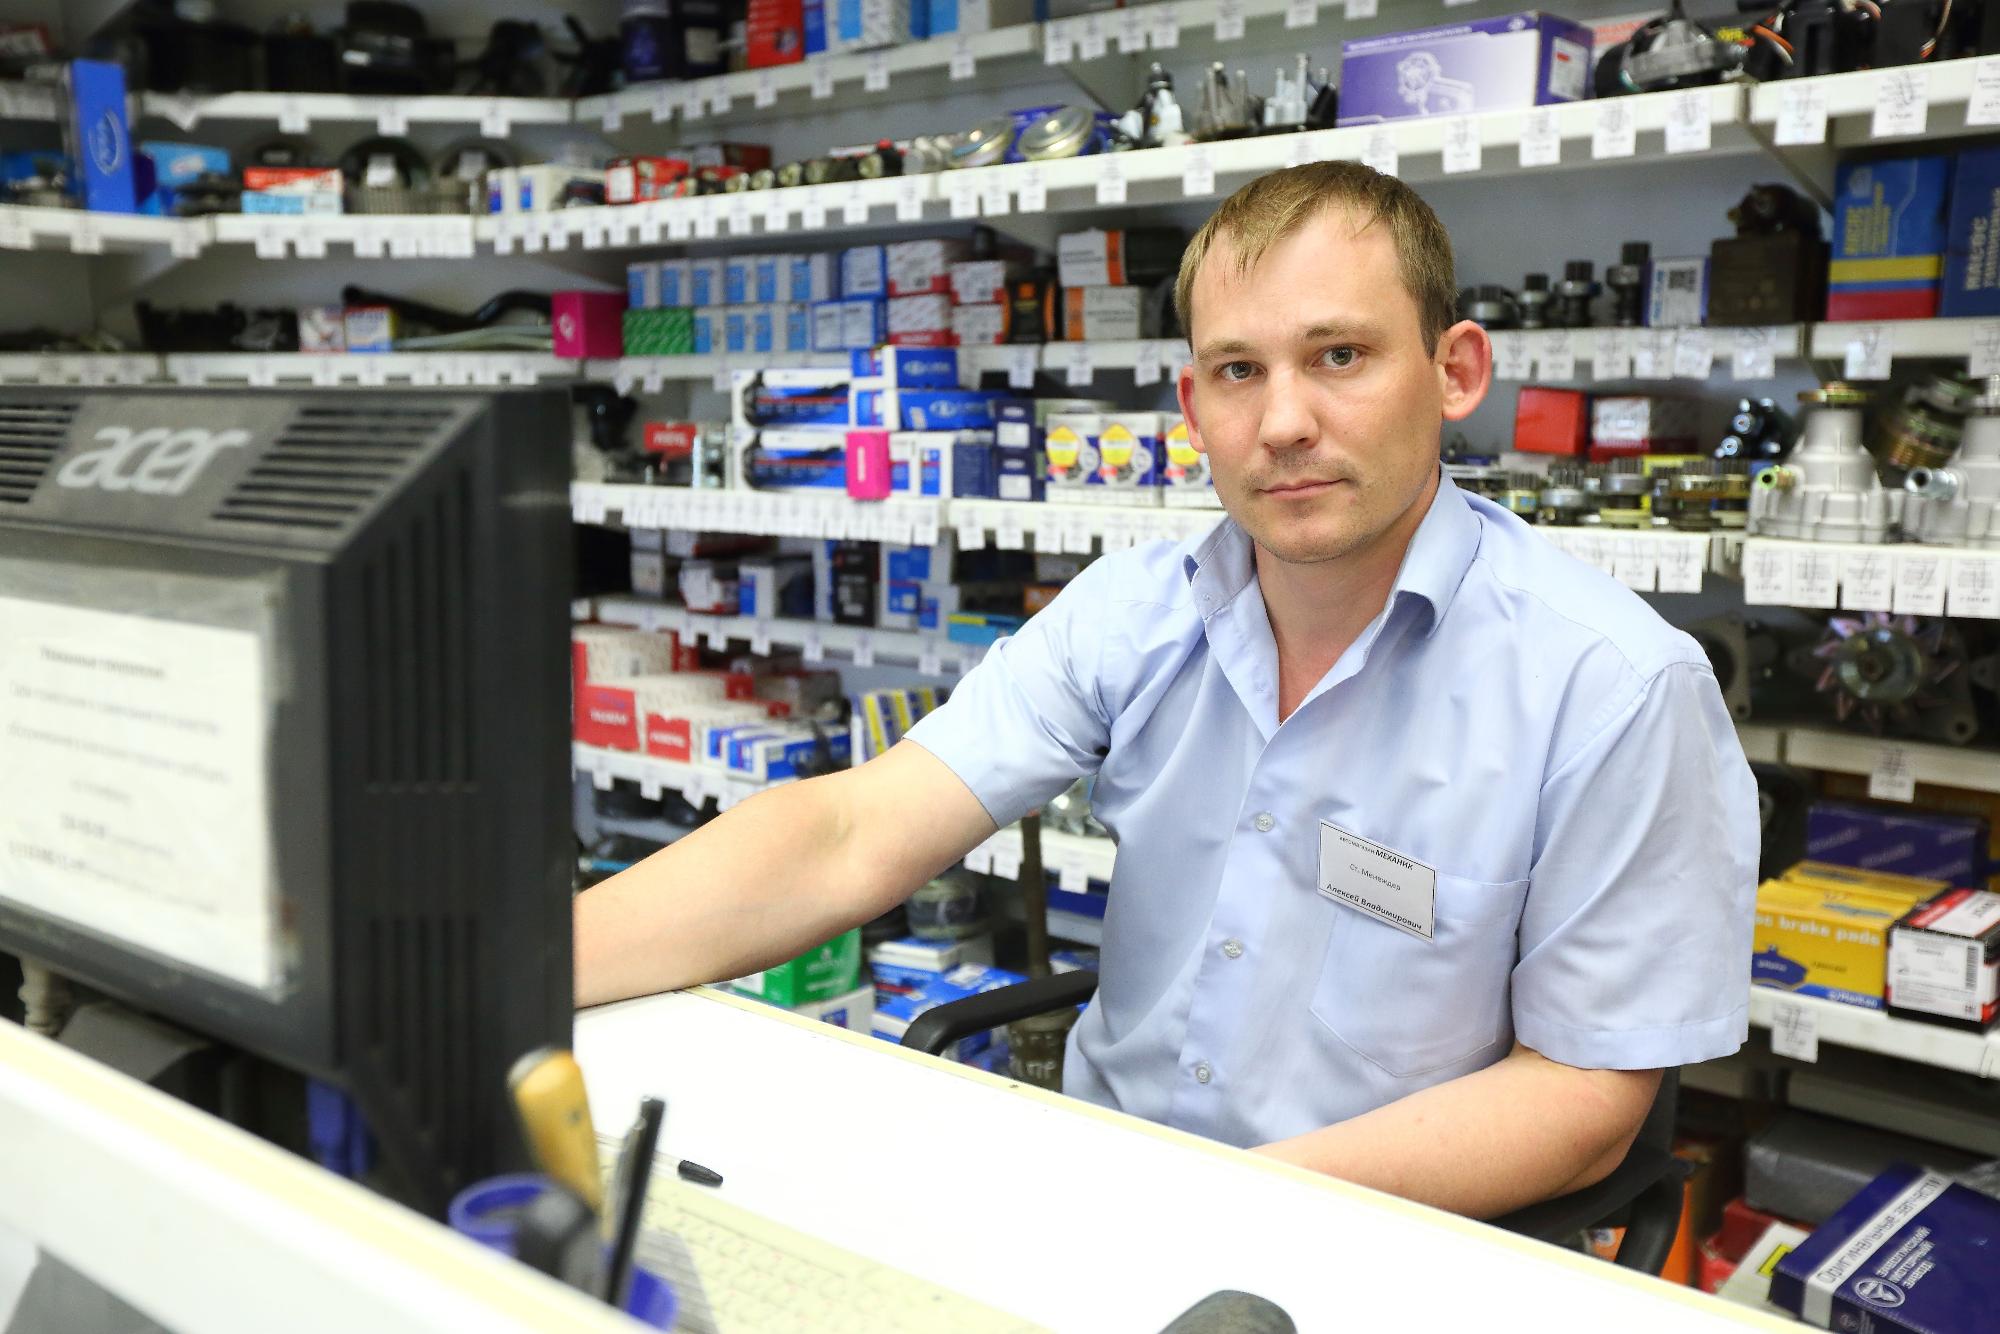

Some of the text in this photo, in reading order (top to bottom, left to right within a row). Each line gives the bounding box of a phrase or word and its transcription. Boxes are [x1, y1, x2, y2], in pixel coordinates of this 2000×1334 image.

[57, 426, 251, 495] acer
[1375, 849, 1414, 871] МЕХАНИК
[1326, 883, 1422, 931] Алексей Владимирович
[1779, 914, 1830, 938] brake
[1835, 924, 1881, 946] pads
